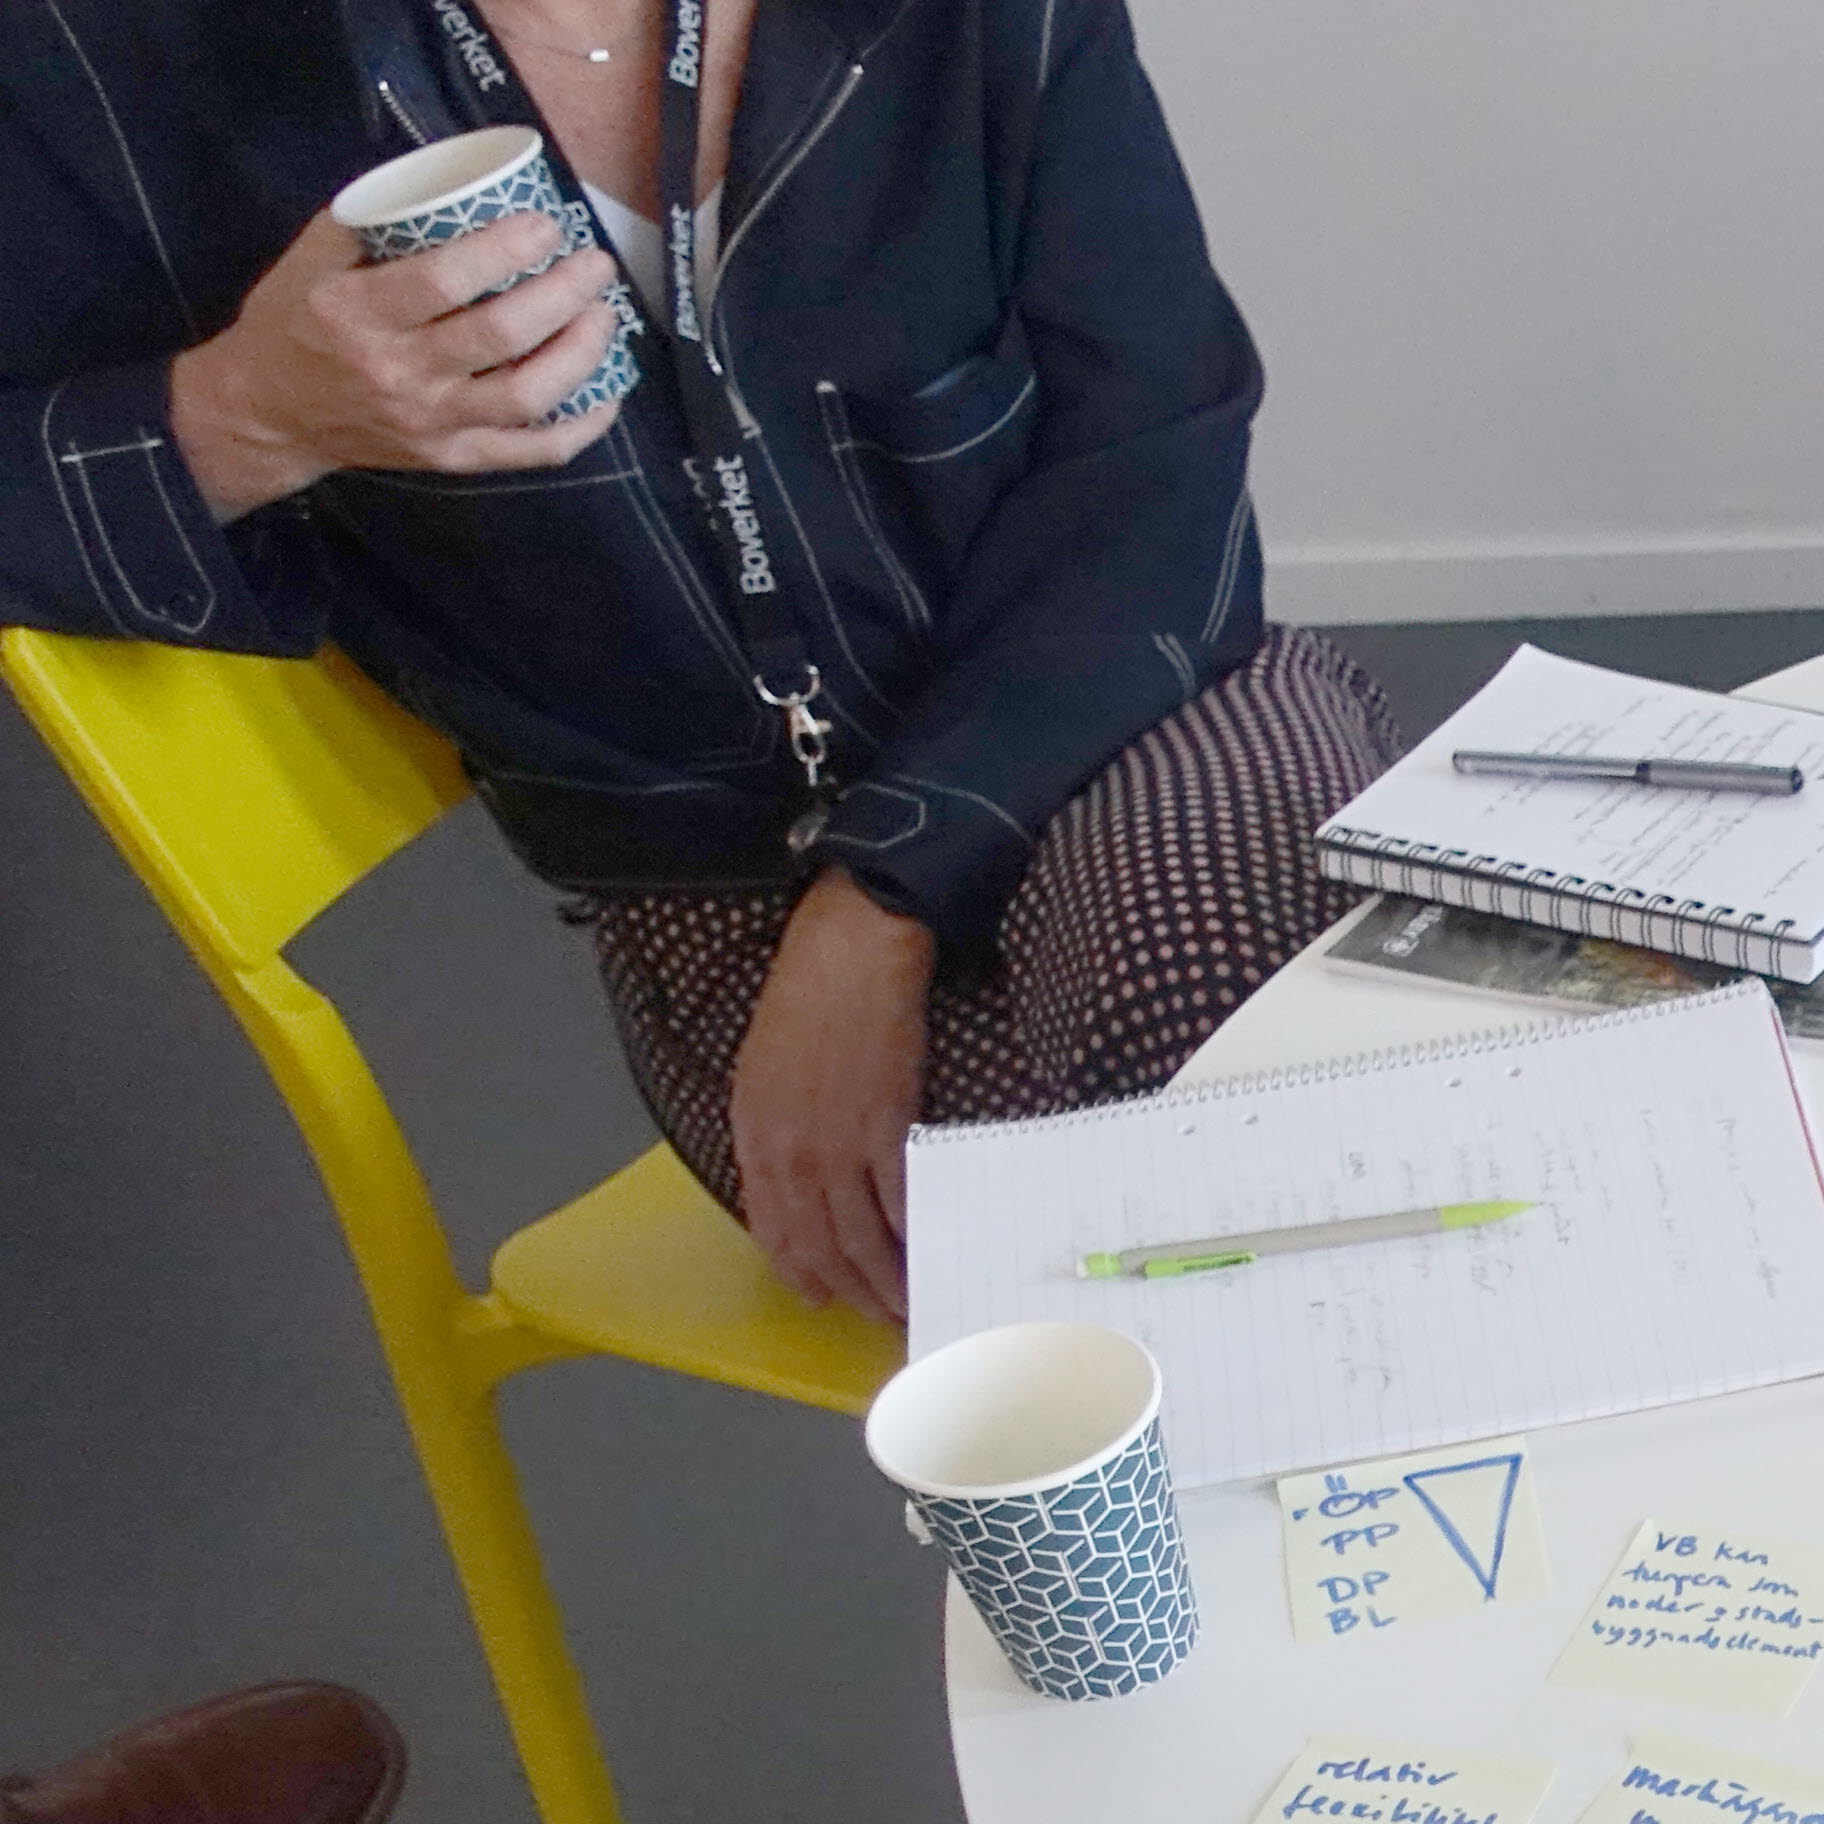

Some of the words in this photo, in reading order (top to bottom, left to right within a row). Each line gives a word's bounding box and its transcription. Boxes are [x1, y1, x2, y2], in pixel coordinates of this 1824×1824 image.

[713, 454, 777, 595] Boverket
[1320, 1522, 1400, 1555] PP
[1656, 1532, 1699, 1557] VB
[1316, 1571, 1391, 1604] DP
[1747, 1576, 1800, 1598] som
[1324, 1606, 1398, 1635] BL
[1317, 1757, 1459, 1786] relativ
